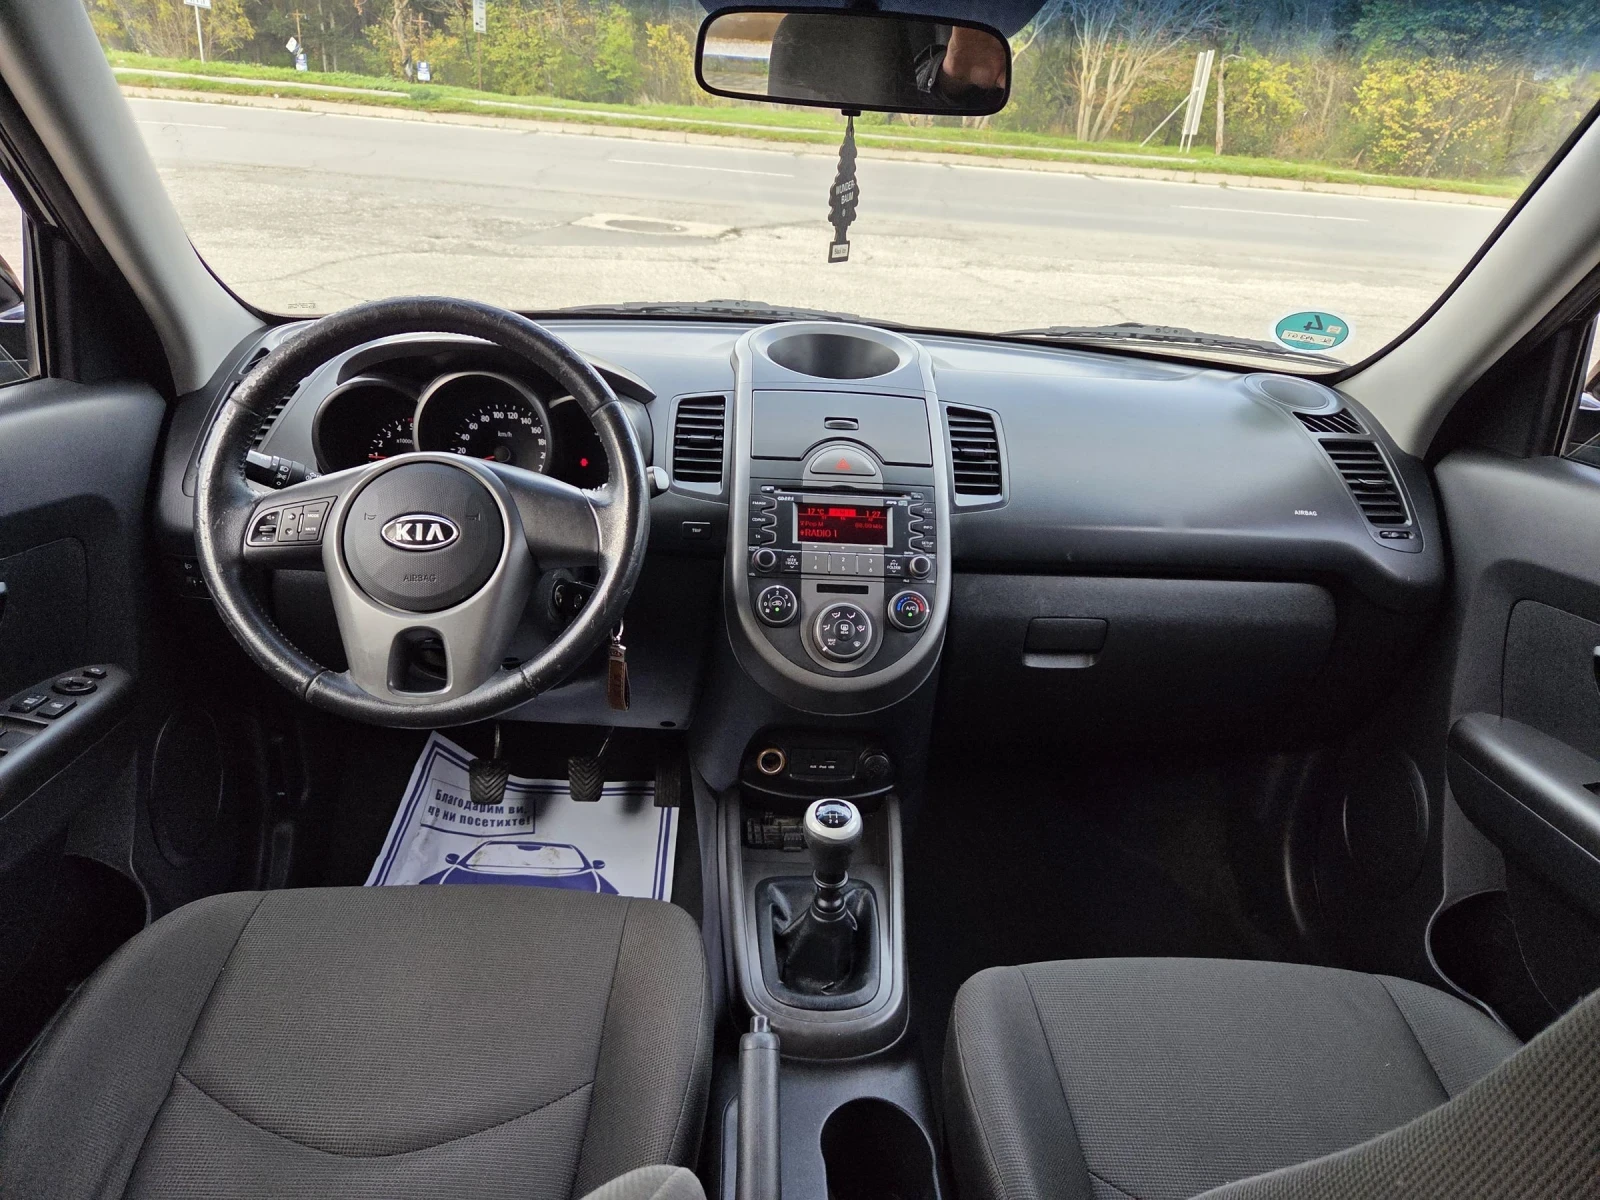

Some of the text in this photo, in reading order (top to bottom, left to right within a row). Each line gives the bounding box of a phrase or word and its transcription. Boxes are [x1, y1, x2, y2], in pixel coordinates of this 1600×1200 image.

[480, 415, 490, 423] 80
[493, 411, 504, 419] 100
[507, 412, 518, 420] 120
[520, 417, 532, 425] 140
[531, 426, 542, 434] 160
[395, 523, 445, 541] KIA
[403, 574, 437, 582] AIRBAG
[435, 789, 504, 815] Благодарим
[442, 811, 456, 822] ни
[460, 815, 531, 828] посетихте!
